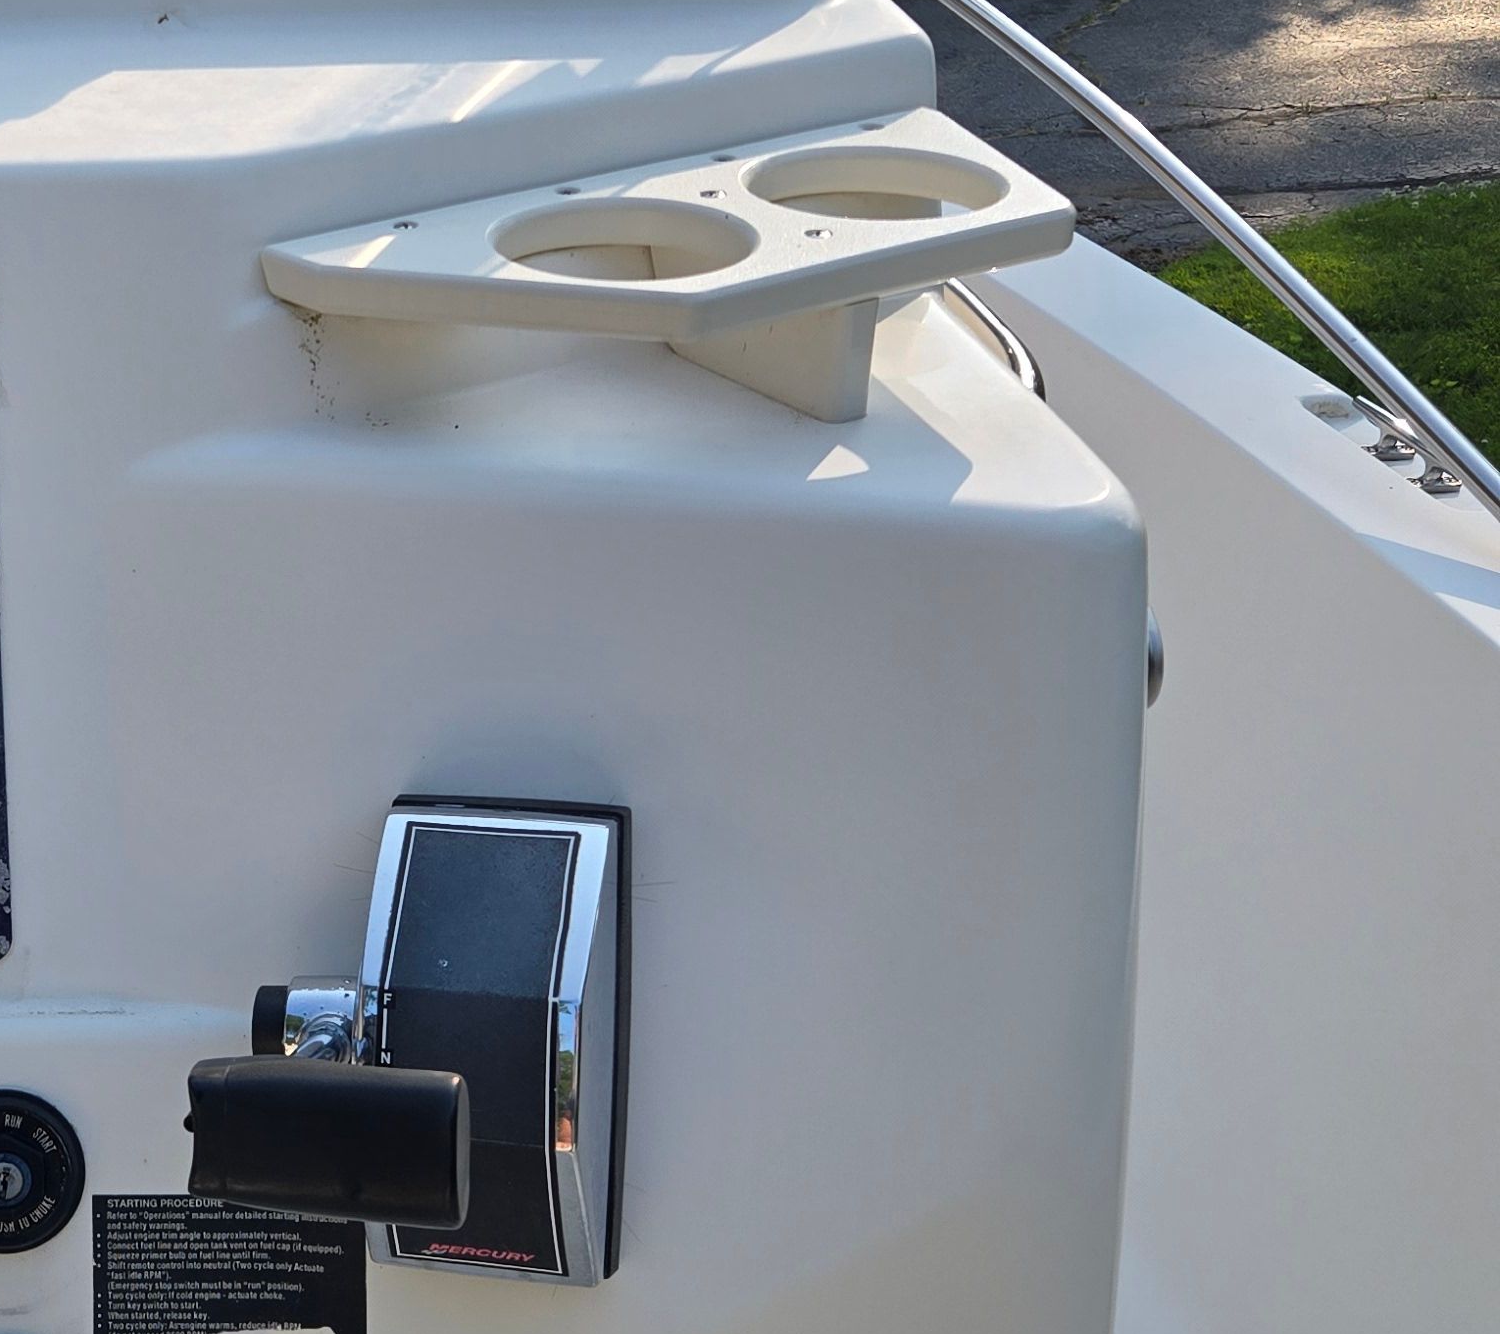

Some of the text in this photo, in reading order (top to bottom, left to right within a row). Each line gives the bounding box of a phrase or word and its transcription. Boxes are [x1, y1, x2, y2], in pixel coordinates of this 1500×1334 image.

[383, 993, 393, 1005] F
[380, 1051, 391, 1064] N
[4, 1114, 23, 1129] RUN
[32, 1127, 58, 1154] START
[107, 1199, 224, 1208] STARTING PROCEDURE
[191, 1211, 220, 1219] manual
[222, 1211, 233, 1219] for
[235, 1211, 267, 1219] detailed
[268, 1212, 300, 1223] starting
[107, 1231, 302, 1241] Adjust engine trim angle approximately vertical.
[107, 1241, 345, 1255] Connect and open tank equipped).
[429, 1243, 536, 1262] MERCURY
[141, 1252, 167, 1260] primer
[232, 1251, 250, 1259] until
[107, 1261, 325, 1273] Shift remote control neutral cycle Actuate
[108, 1281, 153, 1291] (Emergency
[174, 1281, 200, 1289] switch
[201, 1281, 221, 1289] must
[108, 1291, 286, 1301] Two cycle cold engine actuate choke.
[108, 1301, 202, 1311] Turn key switch start.
[108, 1311, 129, 1320] When
[163, 1311, 192, 1320] release
[108, 1321, 266, 1331] Two cycle reduce
